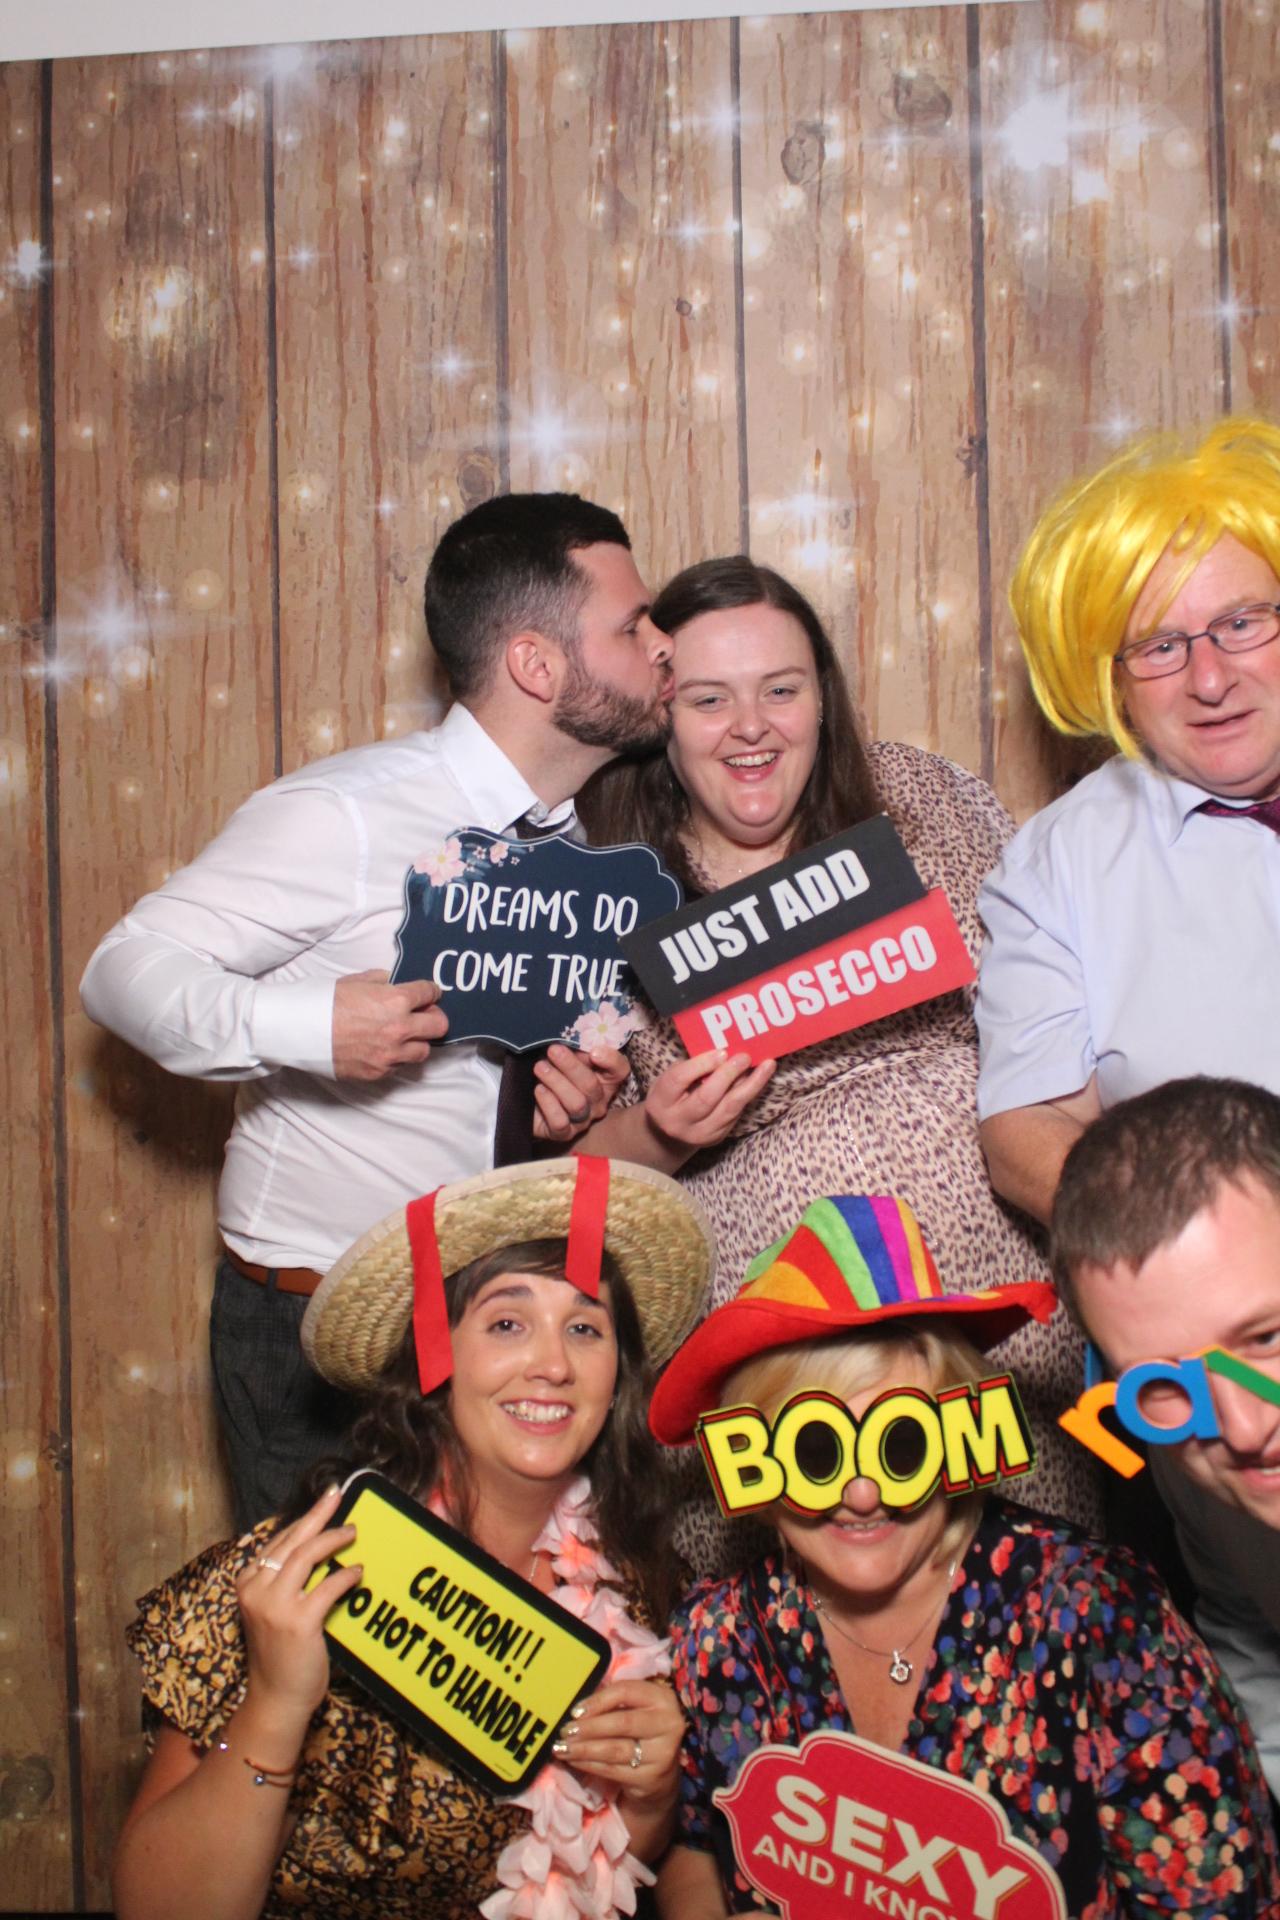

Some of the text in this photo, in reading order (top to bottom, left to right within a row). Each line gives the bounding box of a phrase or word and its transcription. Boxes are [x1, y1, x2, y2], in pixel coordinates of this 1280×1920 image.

[443, 882, 639, 939] DREAMS DO
[658, 848, 871, 984] JUST ADD
[432, 948, 628, 1003] COME TRUE
[700, 925, 938, 1051] PROSECCO
[697, 1374, 1036, 1518] BOOM
[364, 1599, 428, 1661] HOT
[415, 1638, 456, 1689] TO
[443, 1665, 548, 1765] HANDLE
[408, 1566, 546, 1683] CAUTION!!
[752, 1834, 835, 1887] AND
[844, 1871, 854, 1897] I
[771, 1775, 1031, 1920] SEXY
